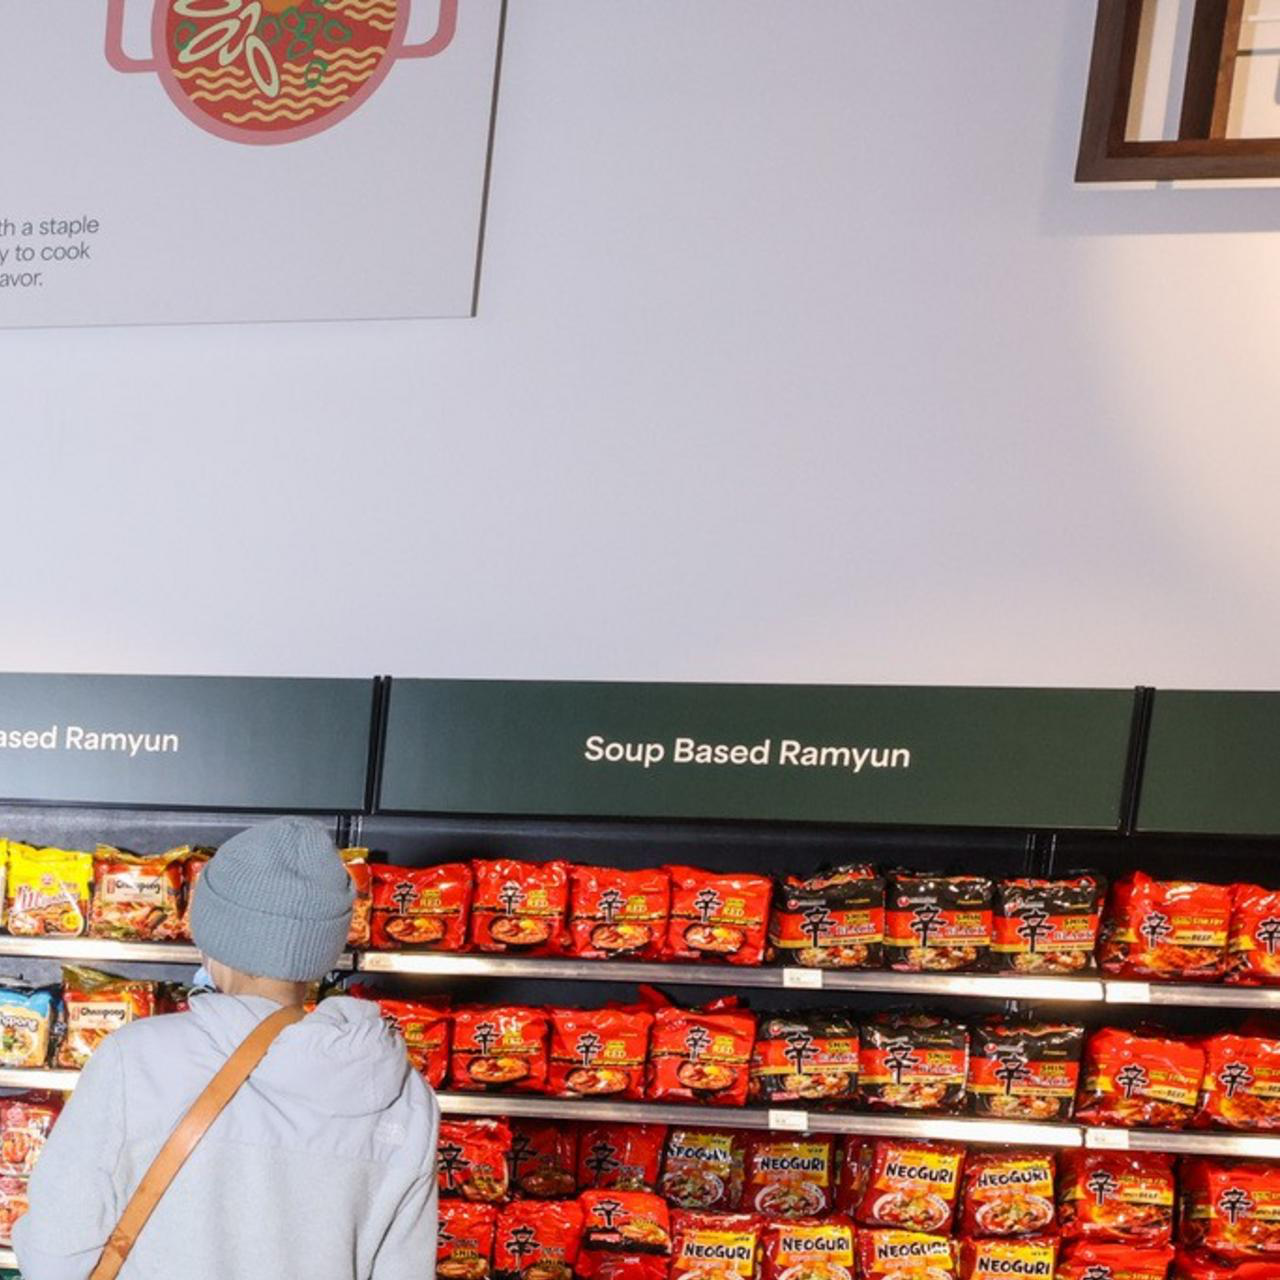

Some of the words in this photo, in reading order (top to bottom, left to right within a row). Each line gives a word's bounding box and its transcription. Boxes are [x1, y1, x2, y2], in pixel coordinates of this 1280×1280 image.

[21, 222, 33, 236] a
[39, 215, 100, 238] staple
[15, 244, 35, 262] to
[40, 241, 91, 261] cook
[65, 725, 179, 756] Ramyun
[583, 734, 665, 768] Soup
[673, 736, 770, 766] Based
[779, 738, 911, 773] Ramyun
[393, 883, 419, 915] 辛
[498, 882, 526, 915] 辛
[597, 889, 626, 922] 辛
[693, 889, 722, 922] 辛
[800, 906, 836, 948] 辛
[910, 904, 946, 948] 辛
[1018, 908, 1054, 953] 辛
[1142, 912, 1172, 949] 辛
[473, 1022, 502, 1055] 辛
[575, 1032, 602, 1066] 辛
[684, 1026, 712, 1062] 辛
[785, 1031, 821, 1074] 辛
[884, 1041, 920, 1084] 辛
[994, 1052, 1031, 1096] 辛
[1118, 1065, 1148, 1098] 辛
[1219, 1063, 1253, 1098] 辛
[760, 1156, 825, 1172] NEOGURI
[886, 1162, 954, 1184] NEOGURI
[1088, 1169, 1120, 1206] 辛
[1219, 1188, 1253, 1224] 辛
[685, 1242, 752, 1261] NEOGURI
[782, 1236, 851, 1252] NEOGURI
[978, 1256, 1050, 1276] NEOGURI
